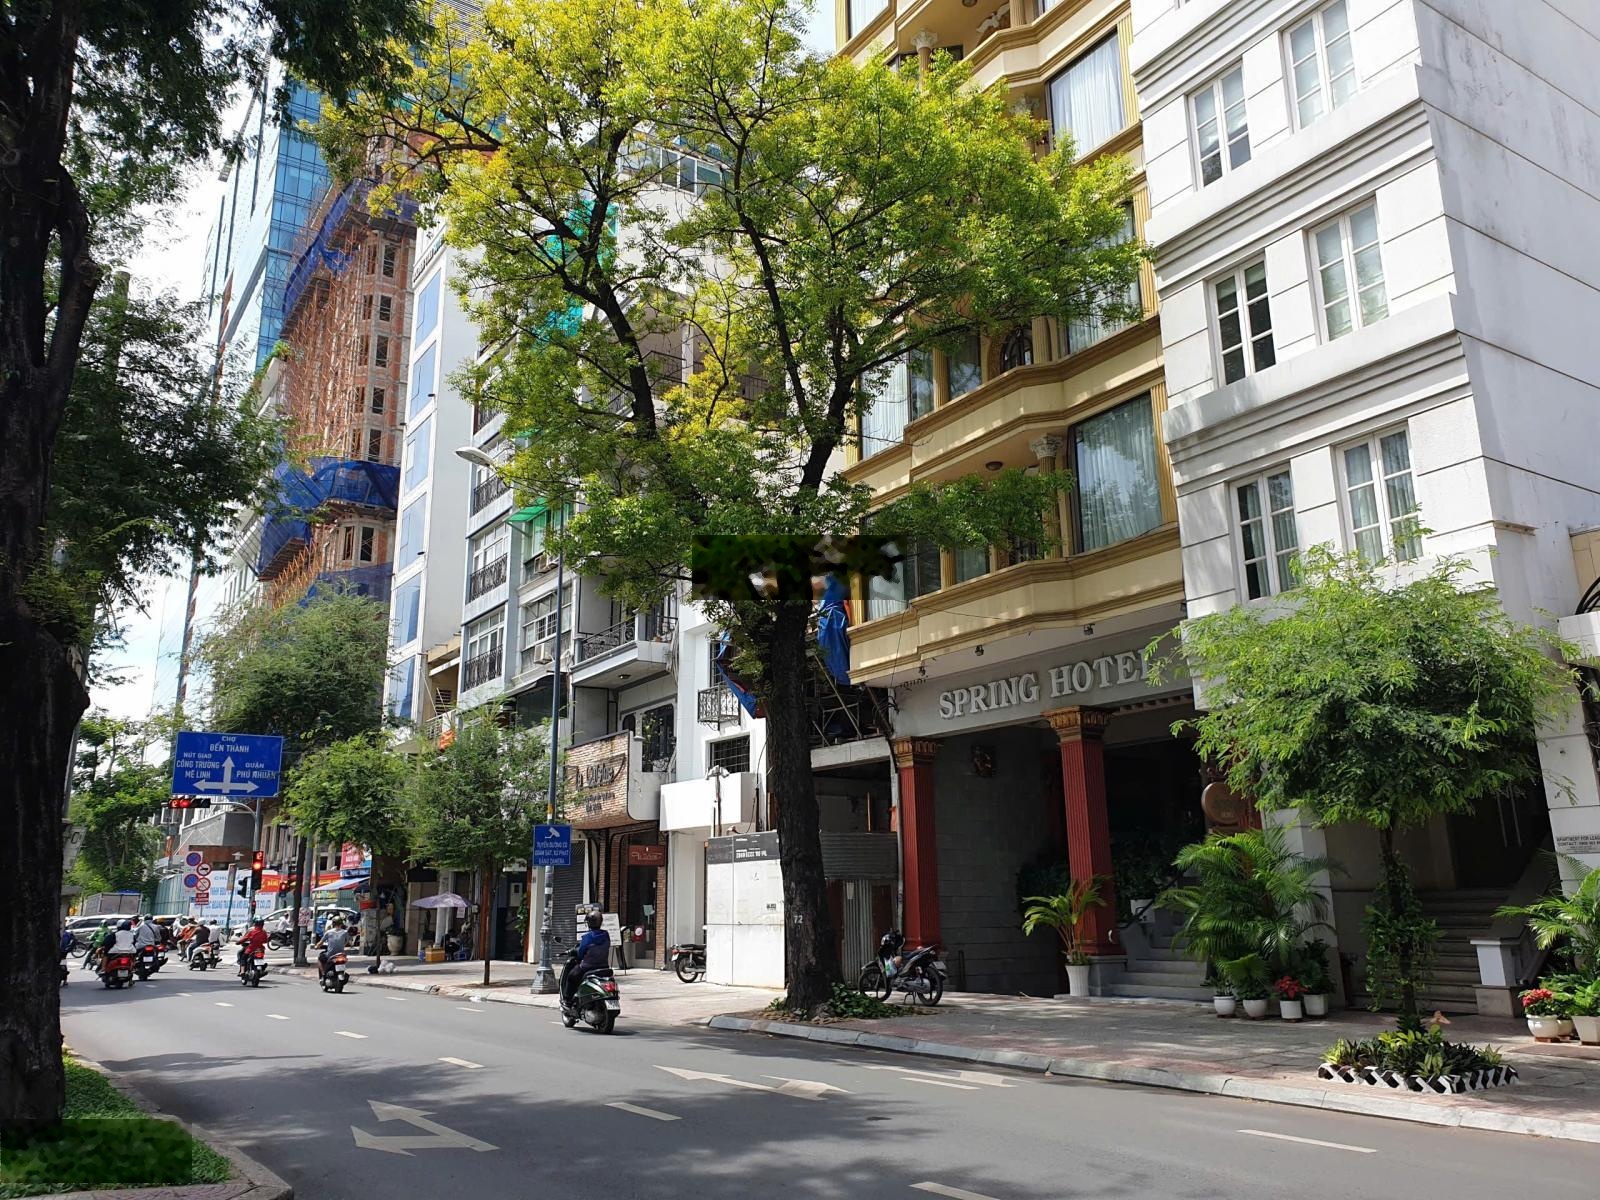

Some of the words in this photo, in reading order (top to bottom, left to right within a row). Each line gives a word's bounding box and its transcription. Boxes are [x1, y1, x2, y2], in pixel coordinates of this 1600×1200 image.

[939, 673, 1039, 718] SPRING
[209, 742, 225, 752] BẾN
[226, 743, 250, 753] THÀNH
[196, 770, 211, 779] LINH
[794, 915, 803, 924] 72
